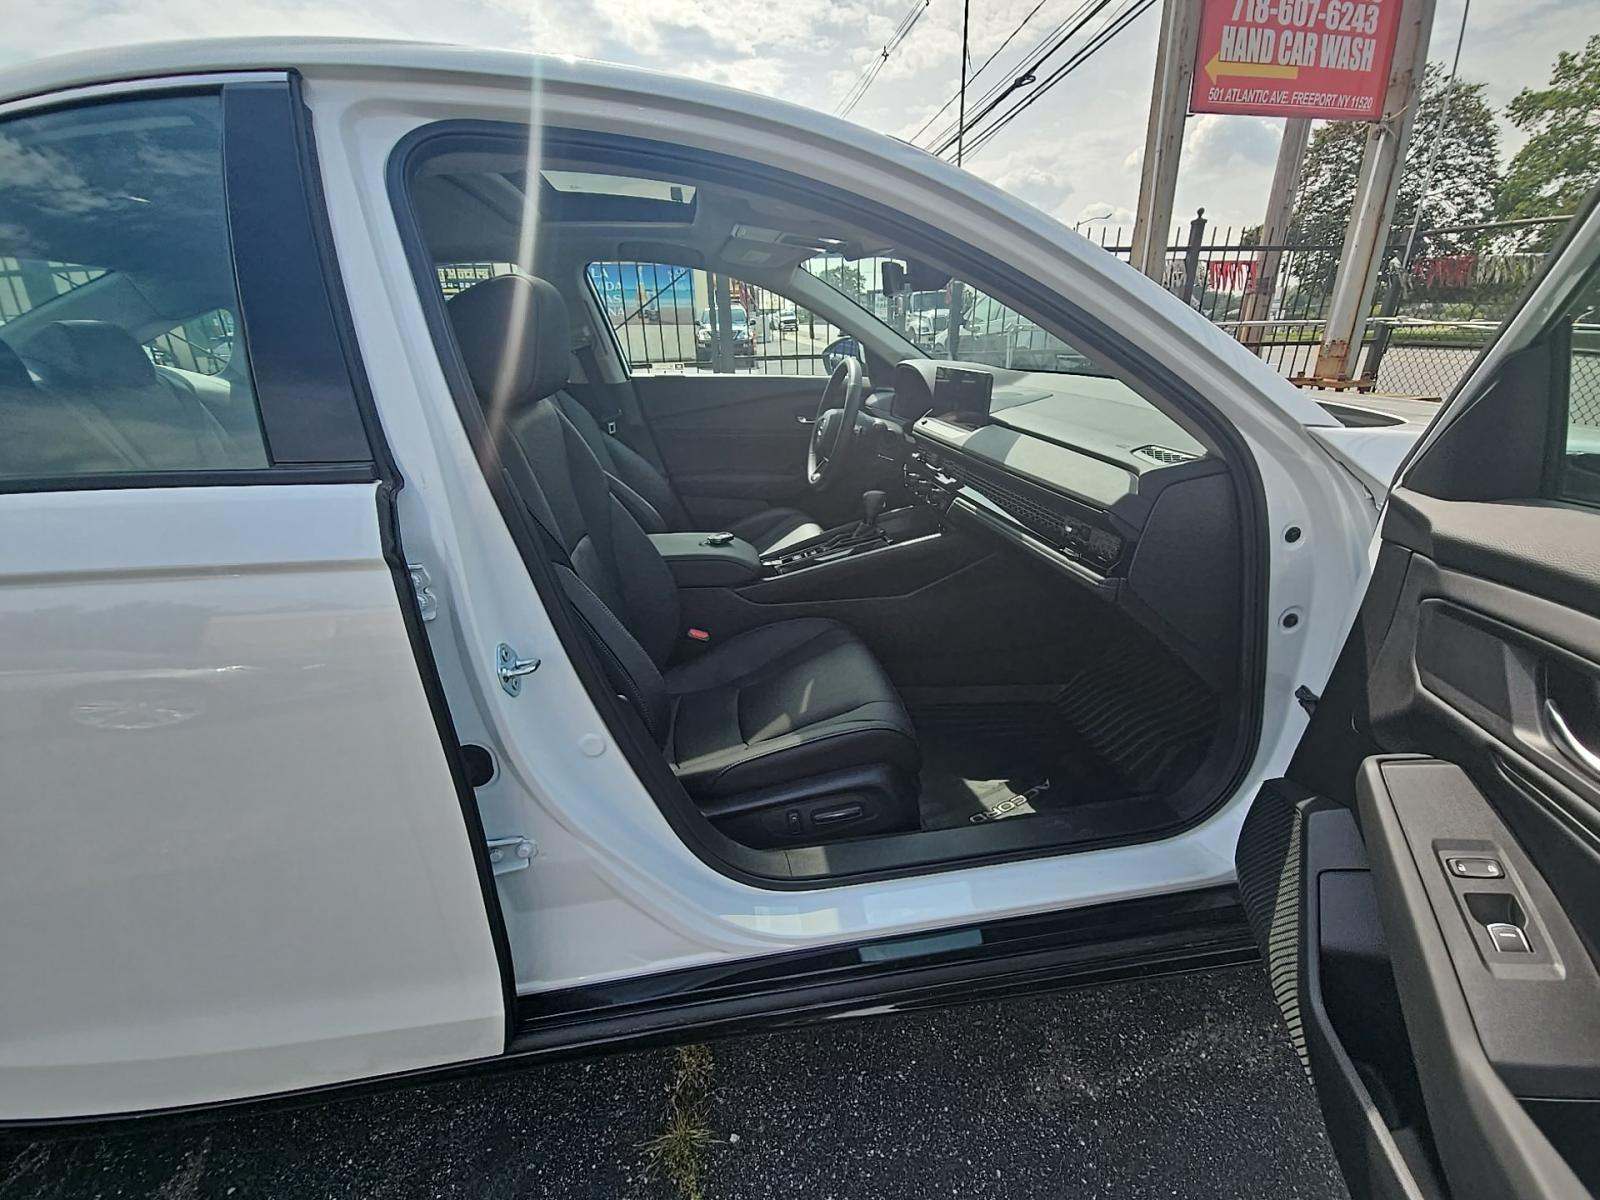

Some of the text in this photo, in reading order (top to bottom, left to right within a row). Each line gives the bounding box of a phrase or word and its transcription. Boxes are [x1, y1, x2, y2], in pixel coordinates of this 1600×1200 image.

[1219, 25, 1376, 72] HAND CAR WASH
[1208, 87, 1225, 101] 501
[1224, 88, 1269, 103] ATLANTIC
[1290, 91, 1338, 107] FREEPORT
[1337, 94, 1351, 107] NY
[1350, 96, 1373, 109] 11520
[595, 281, 622, 291] VDA
